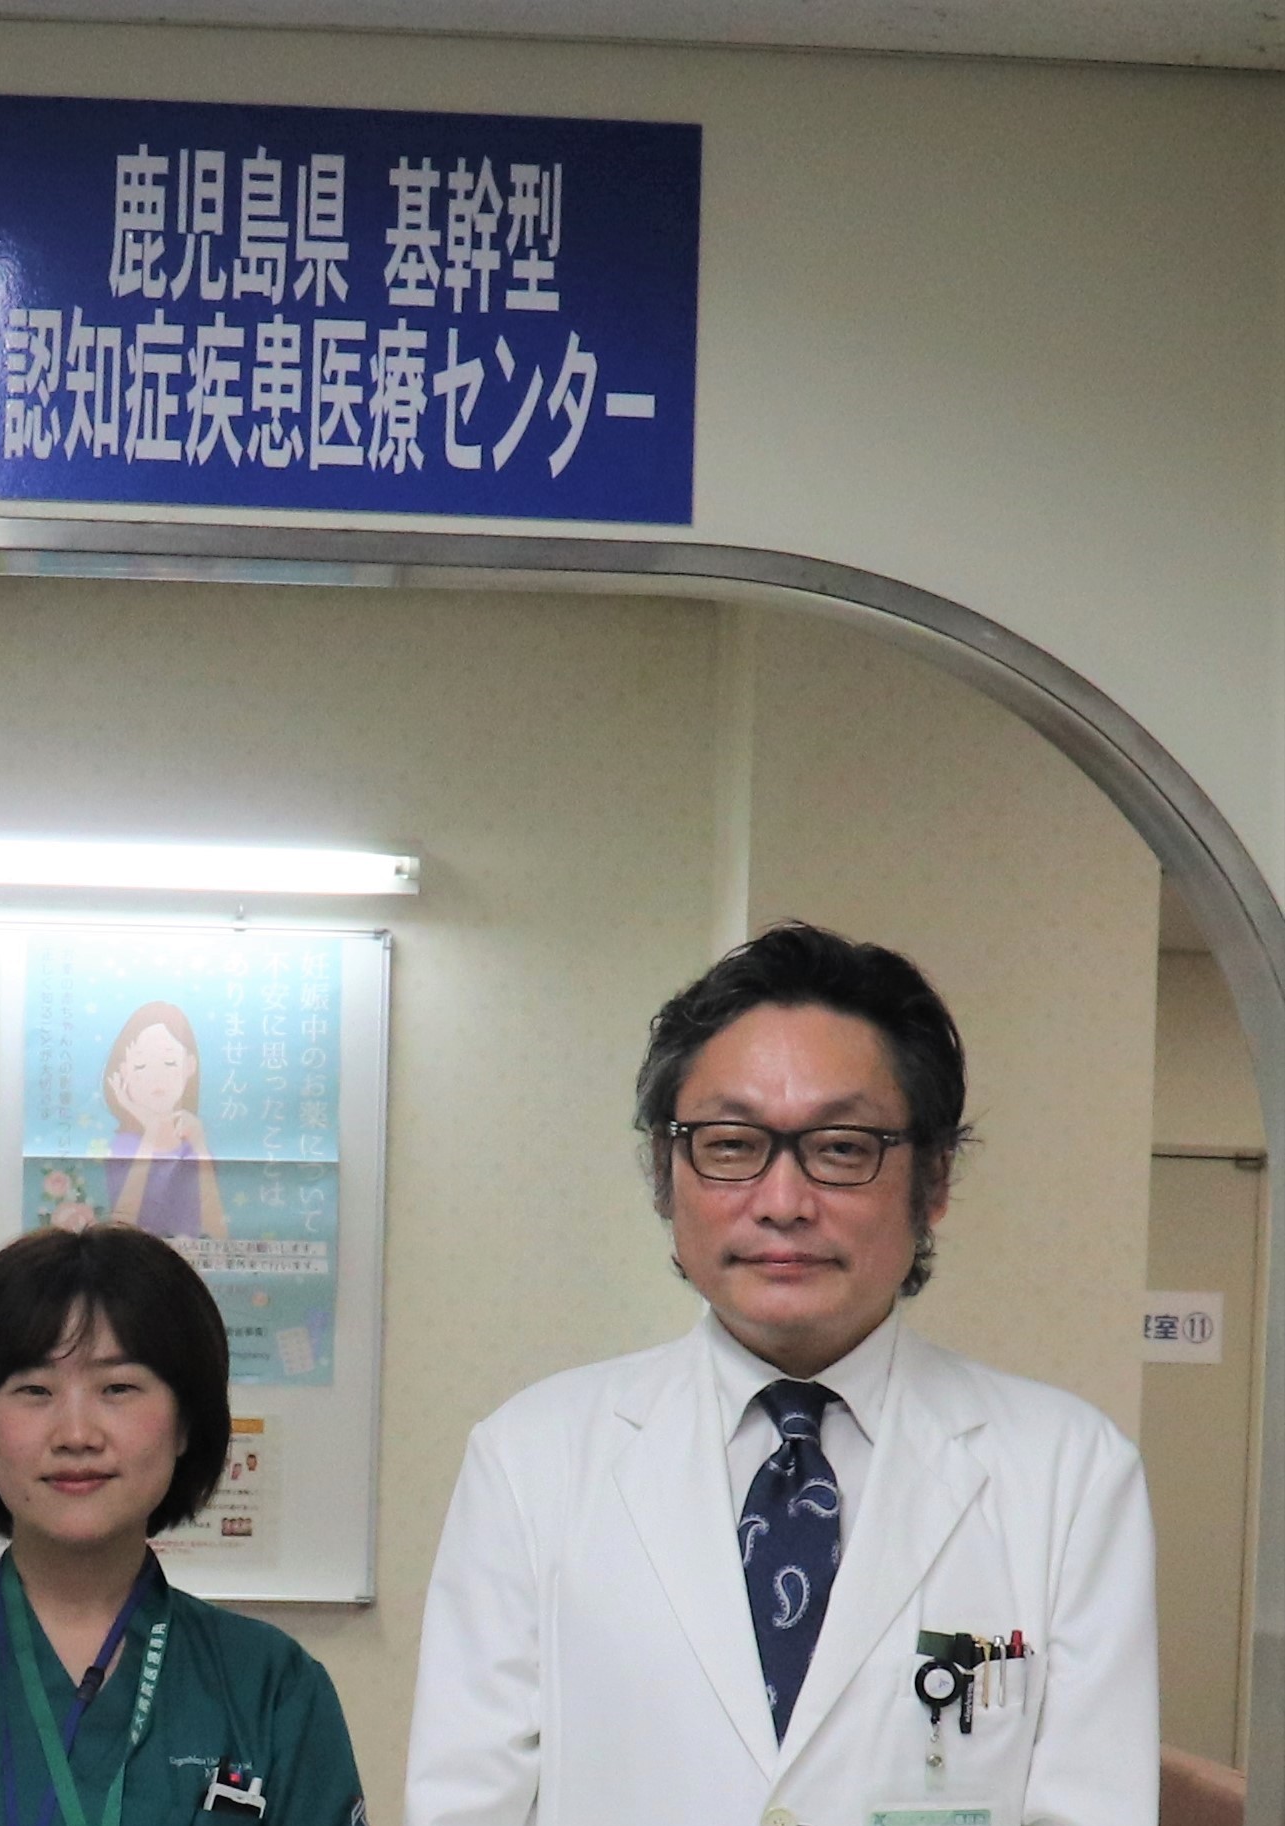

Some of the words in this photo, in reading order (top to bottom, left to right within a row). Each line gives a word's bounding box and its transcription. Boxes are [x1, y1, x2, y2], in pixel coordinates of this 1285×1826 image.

[109, 144, 349, 307] 鹿児島県
[383, 155, 562, 313] 基幹型
[3, 306, 656, 479] 認知症疾患医療センター
[220, 957, 249, 1122] ありませんか
